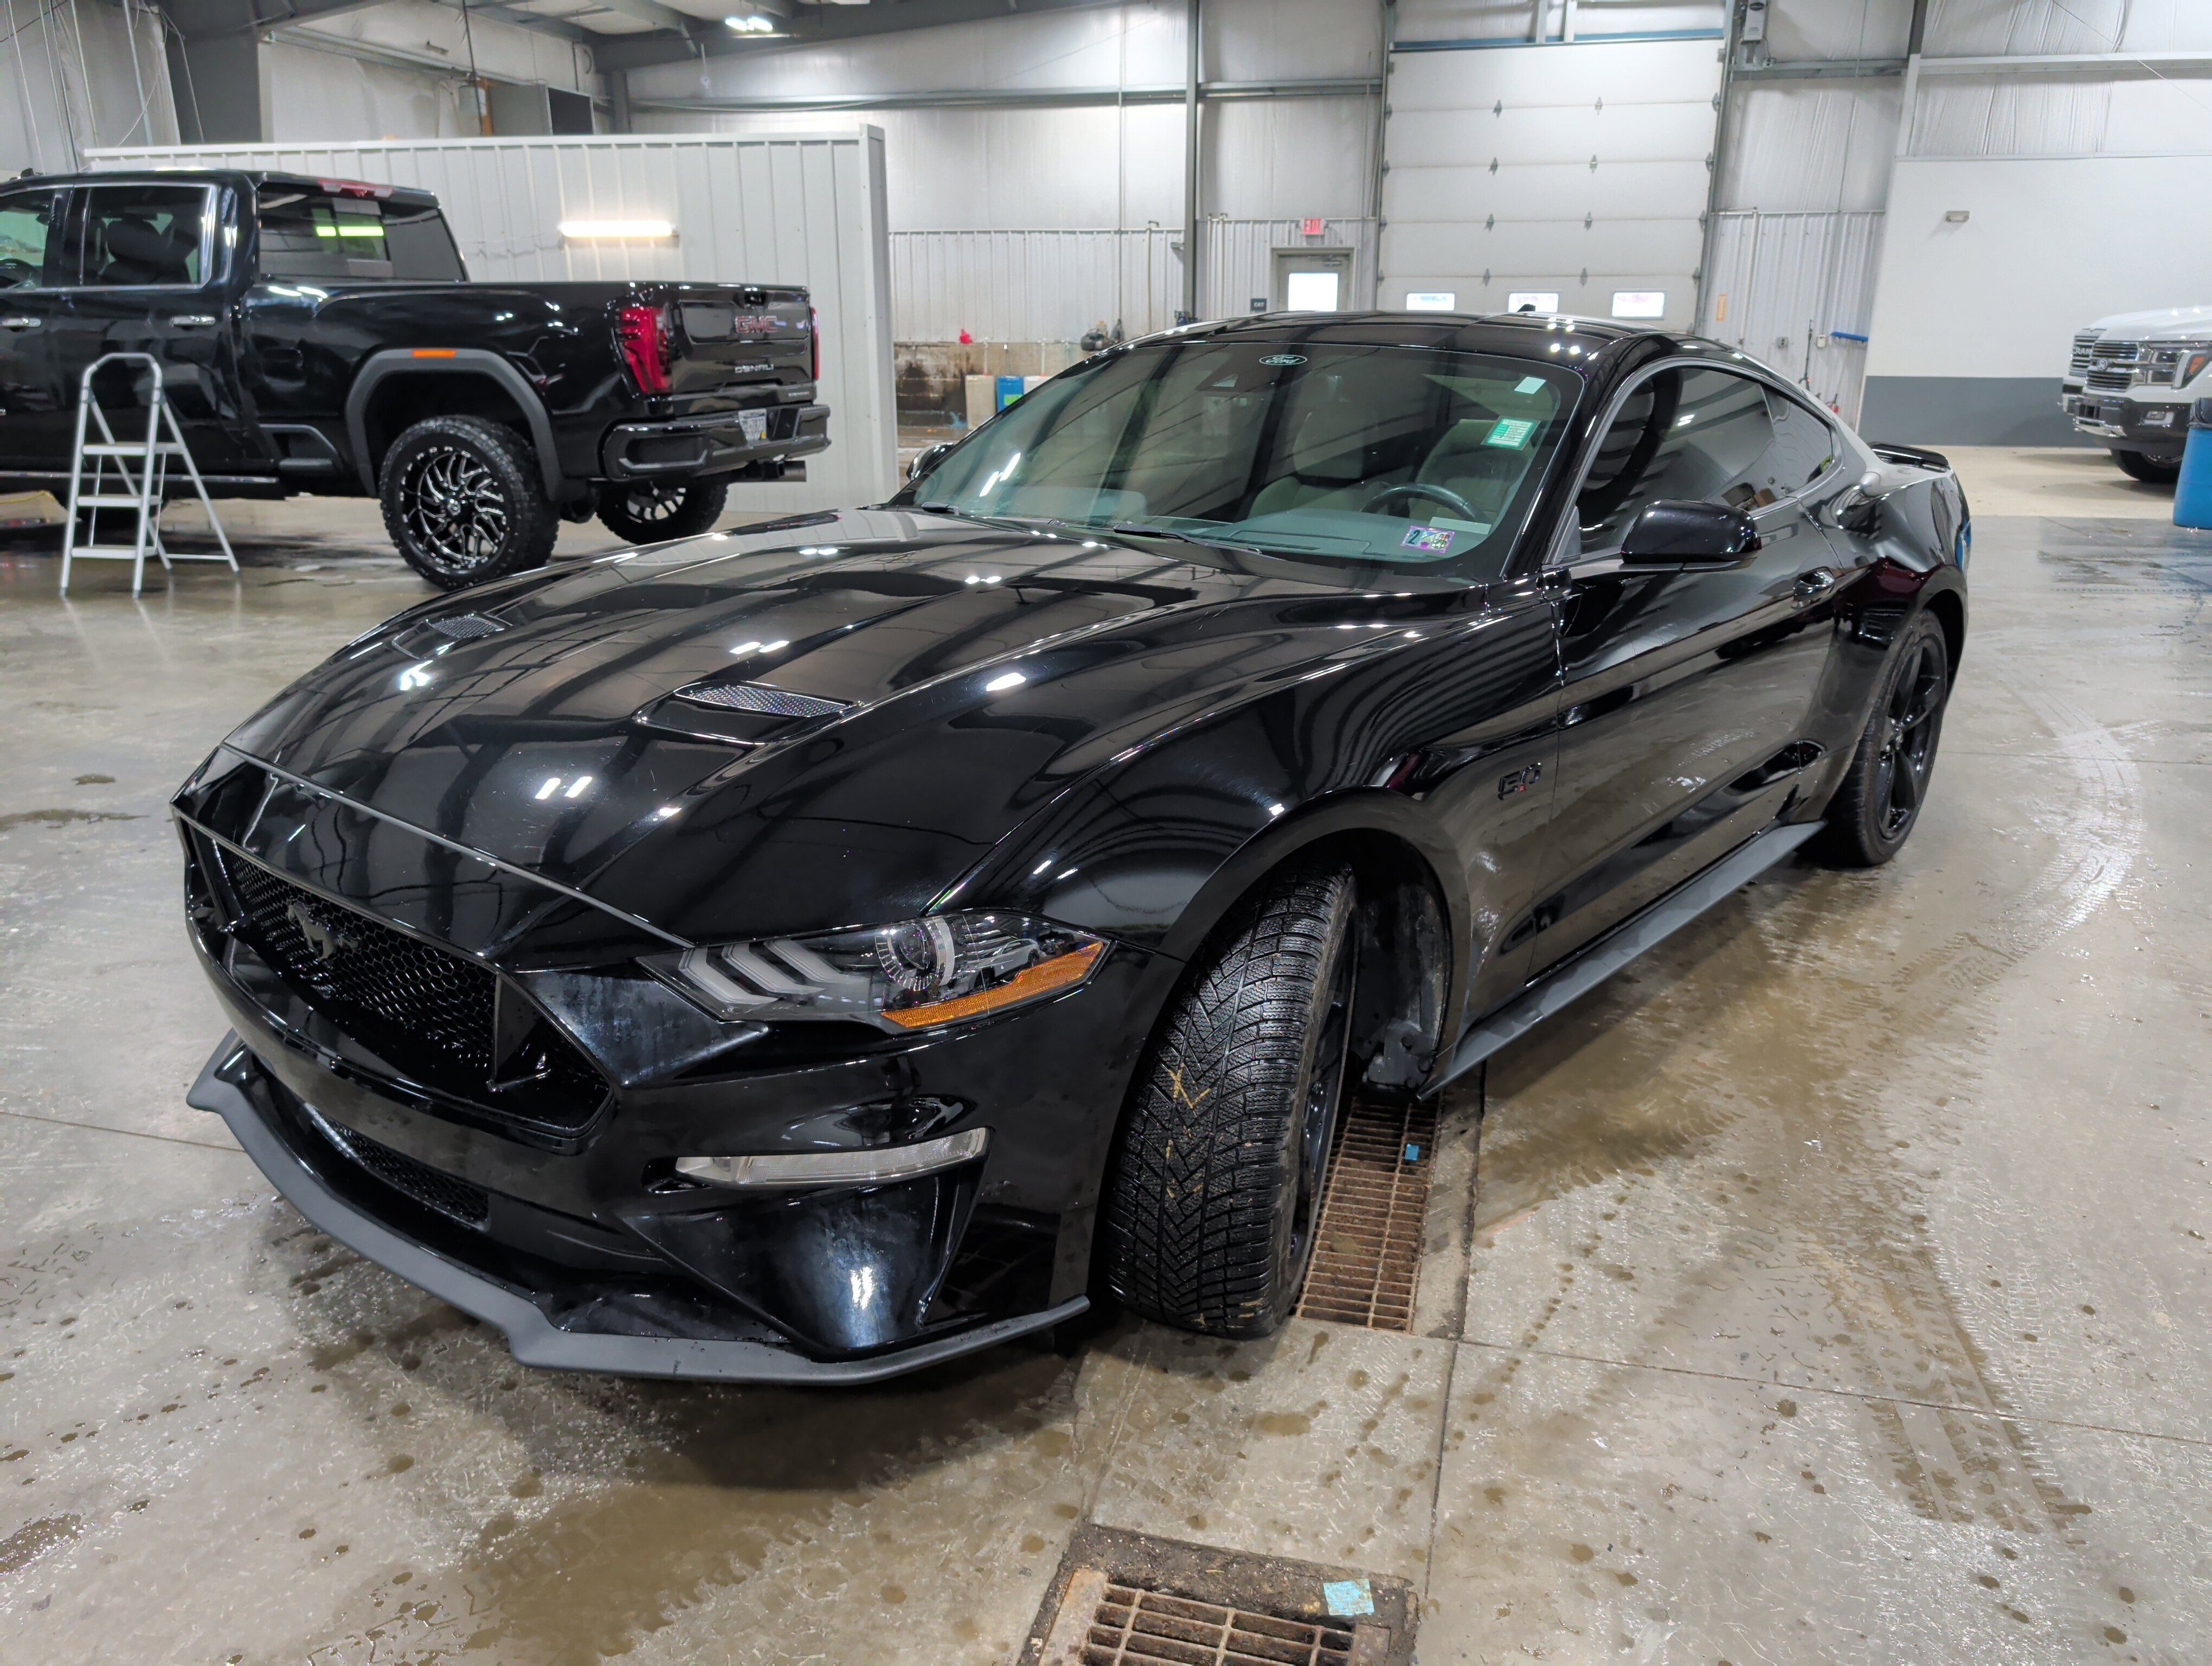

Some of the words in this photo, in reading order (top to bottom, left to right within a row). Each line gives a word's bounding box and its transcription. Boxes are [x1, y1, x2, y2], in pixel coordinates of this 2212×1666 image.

[1304, 218, 1322, 234] EXIT
[735, 315, 778, 333] GMC
[1265, 355, 1300, 364] Ford
[735, 363, 774, 374] DENALI
